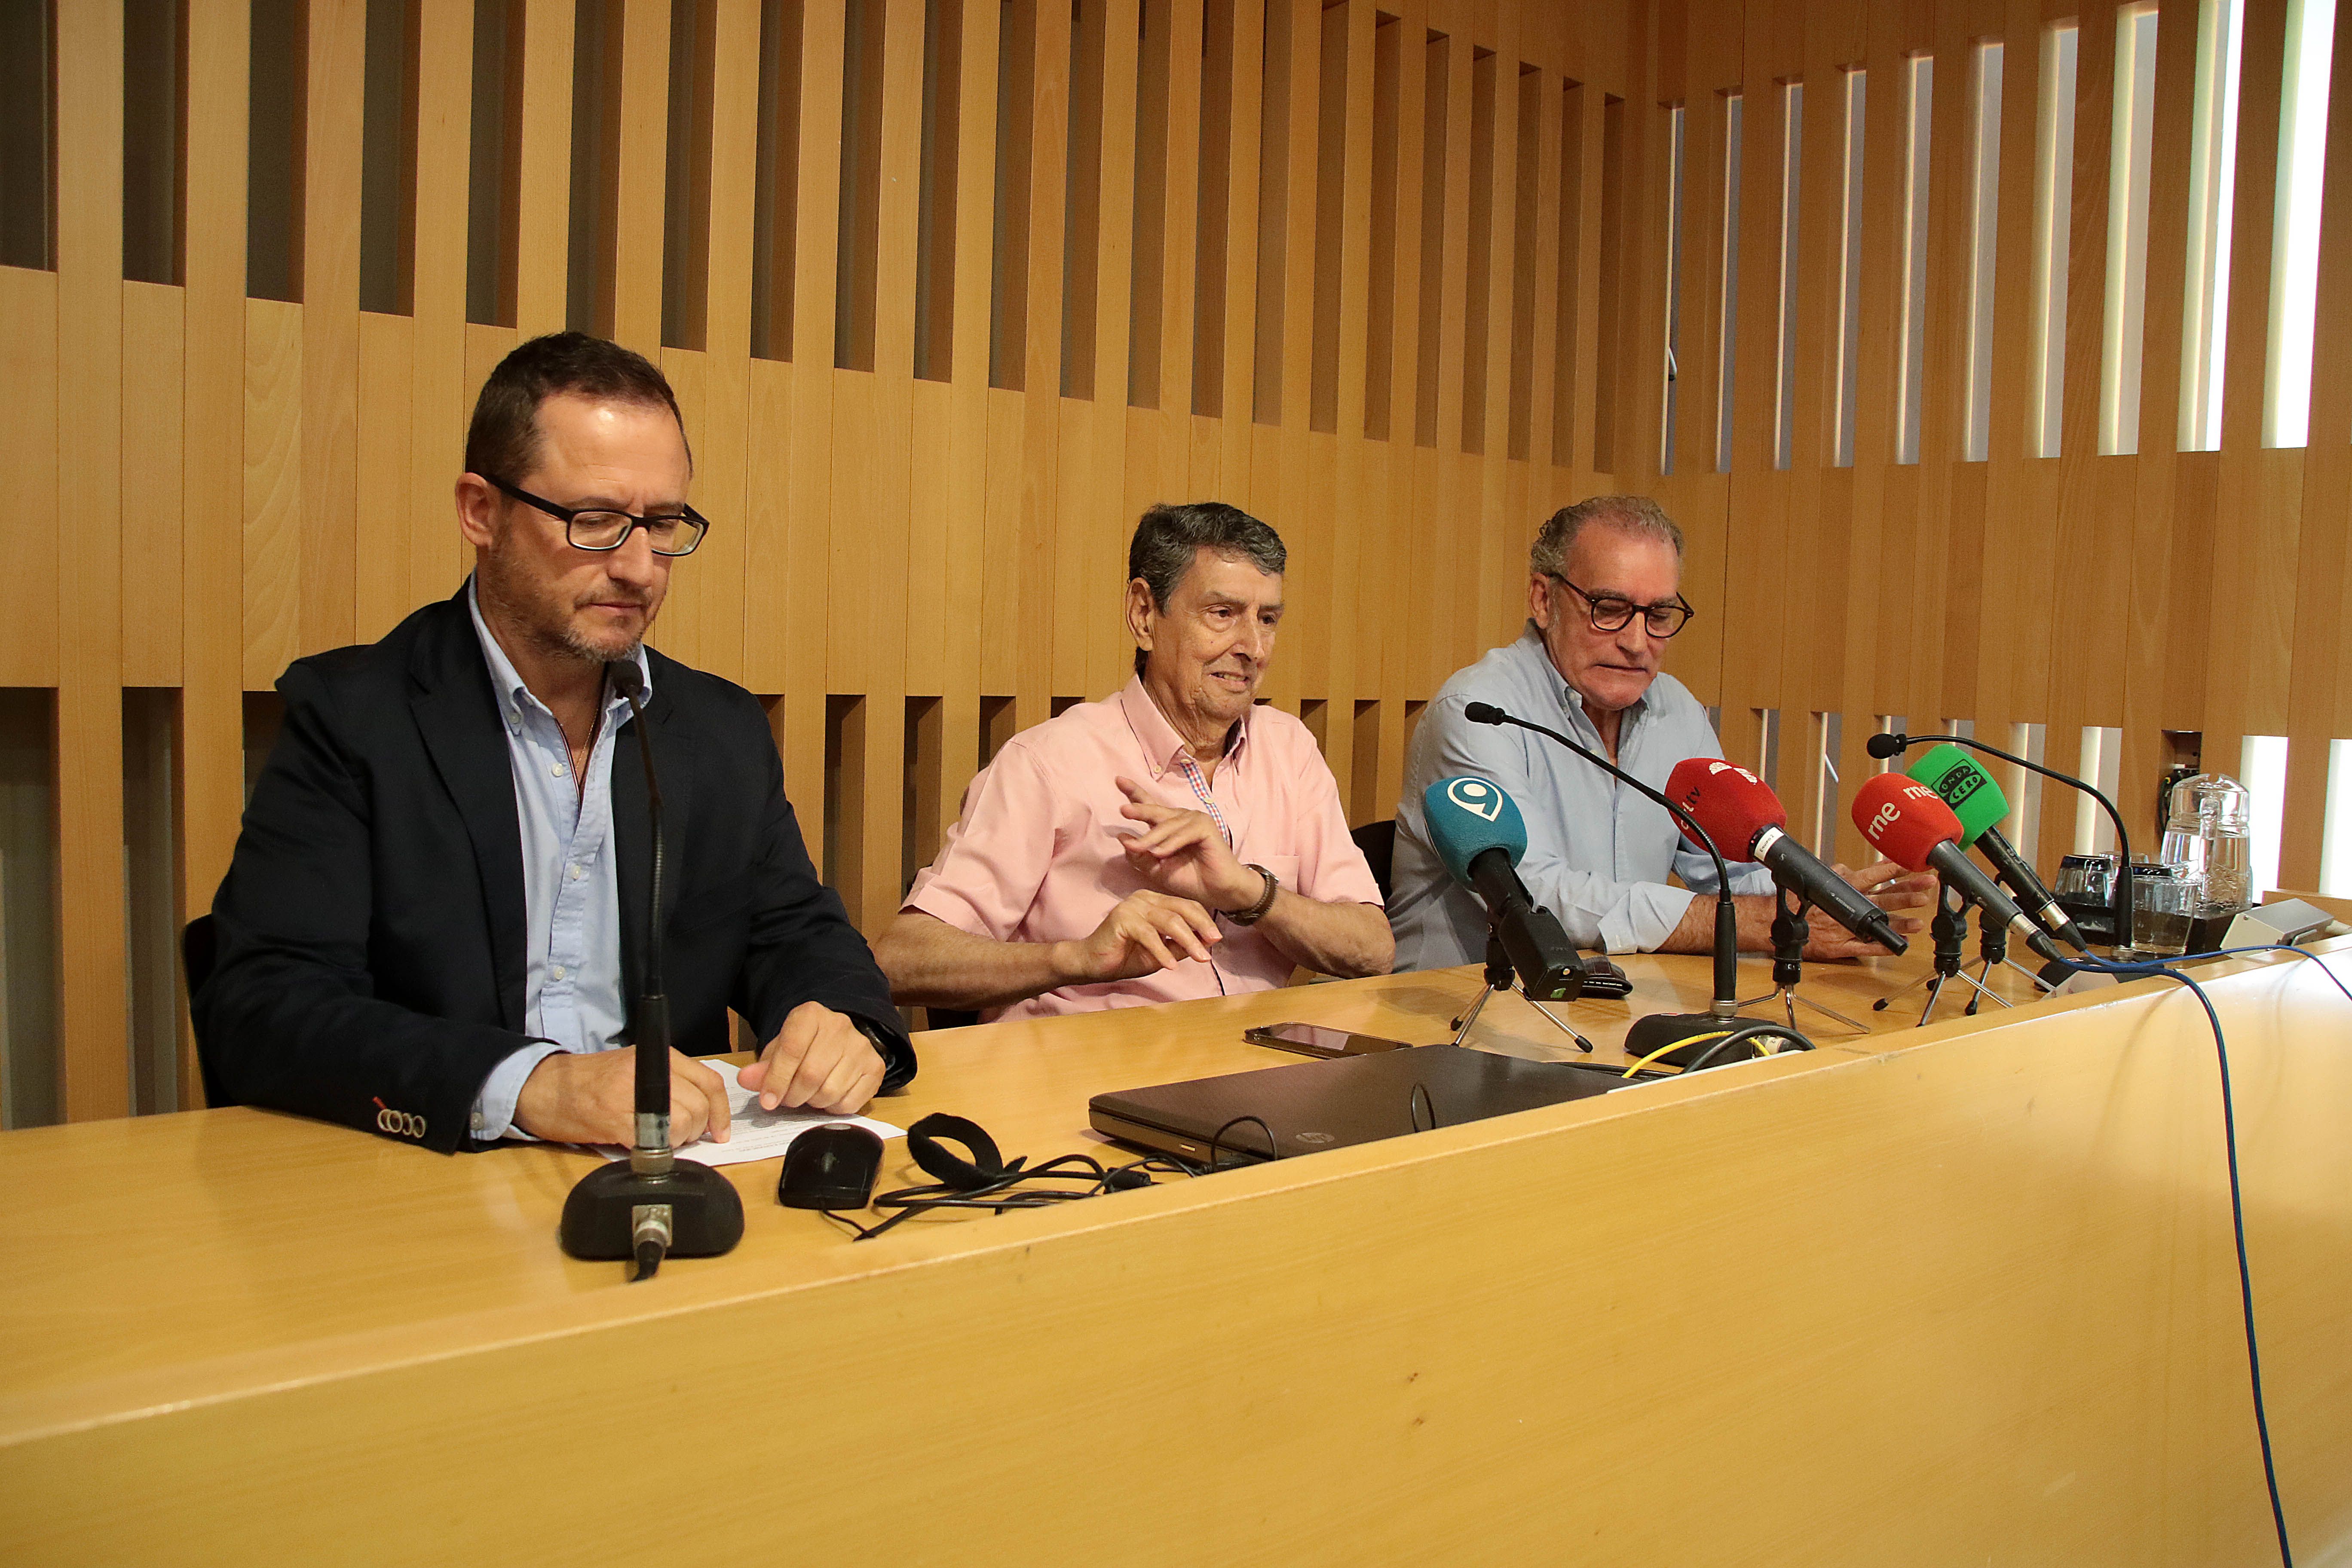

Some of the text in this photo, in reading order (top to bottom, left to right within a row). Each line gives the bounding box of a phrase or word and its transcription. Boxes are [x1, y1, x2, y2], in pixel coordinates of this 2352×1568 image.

[1941, 768, 1969, 790] ONDA
[1952, 776, 1977, 799] CERO
[1902, 786, 1939, 800] rne
[1868, 802, 1901, 840] rne
